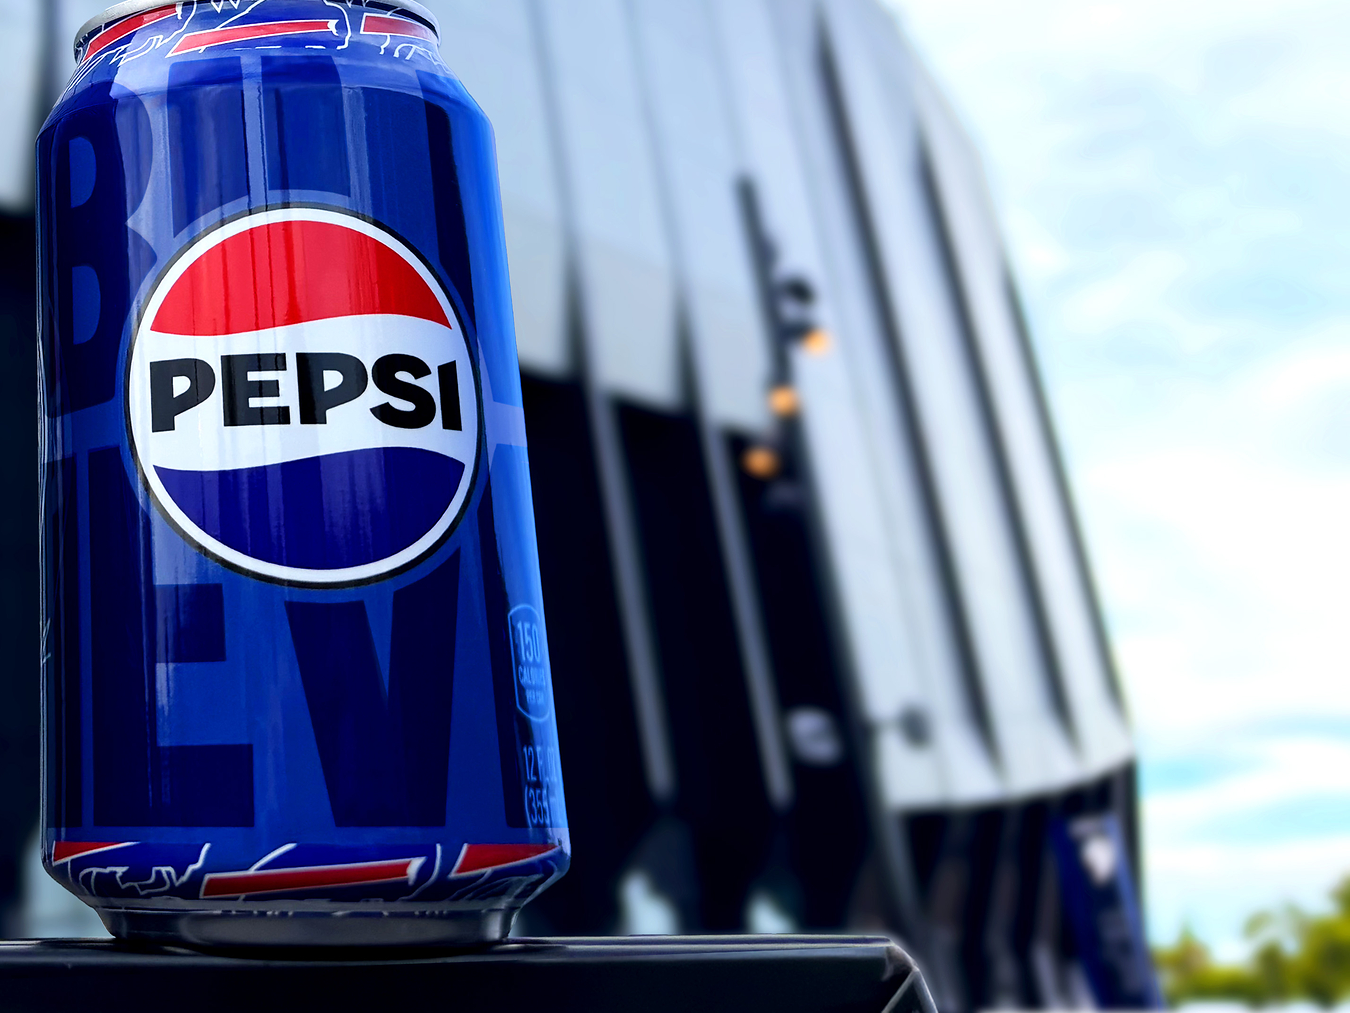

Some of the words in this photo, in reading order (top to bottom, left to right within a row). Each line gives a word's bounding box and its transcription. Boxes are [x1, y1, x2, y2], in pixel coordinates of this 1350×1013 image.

[149, 351, 464, 433] PEPSI
[517, 620, 541, 664] 150
[523, 744, 537, 782] 12
